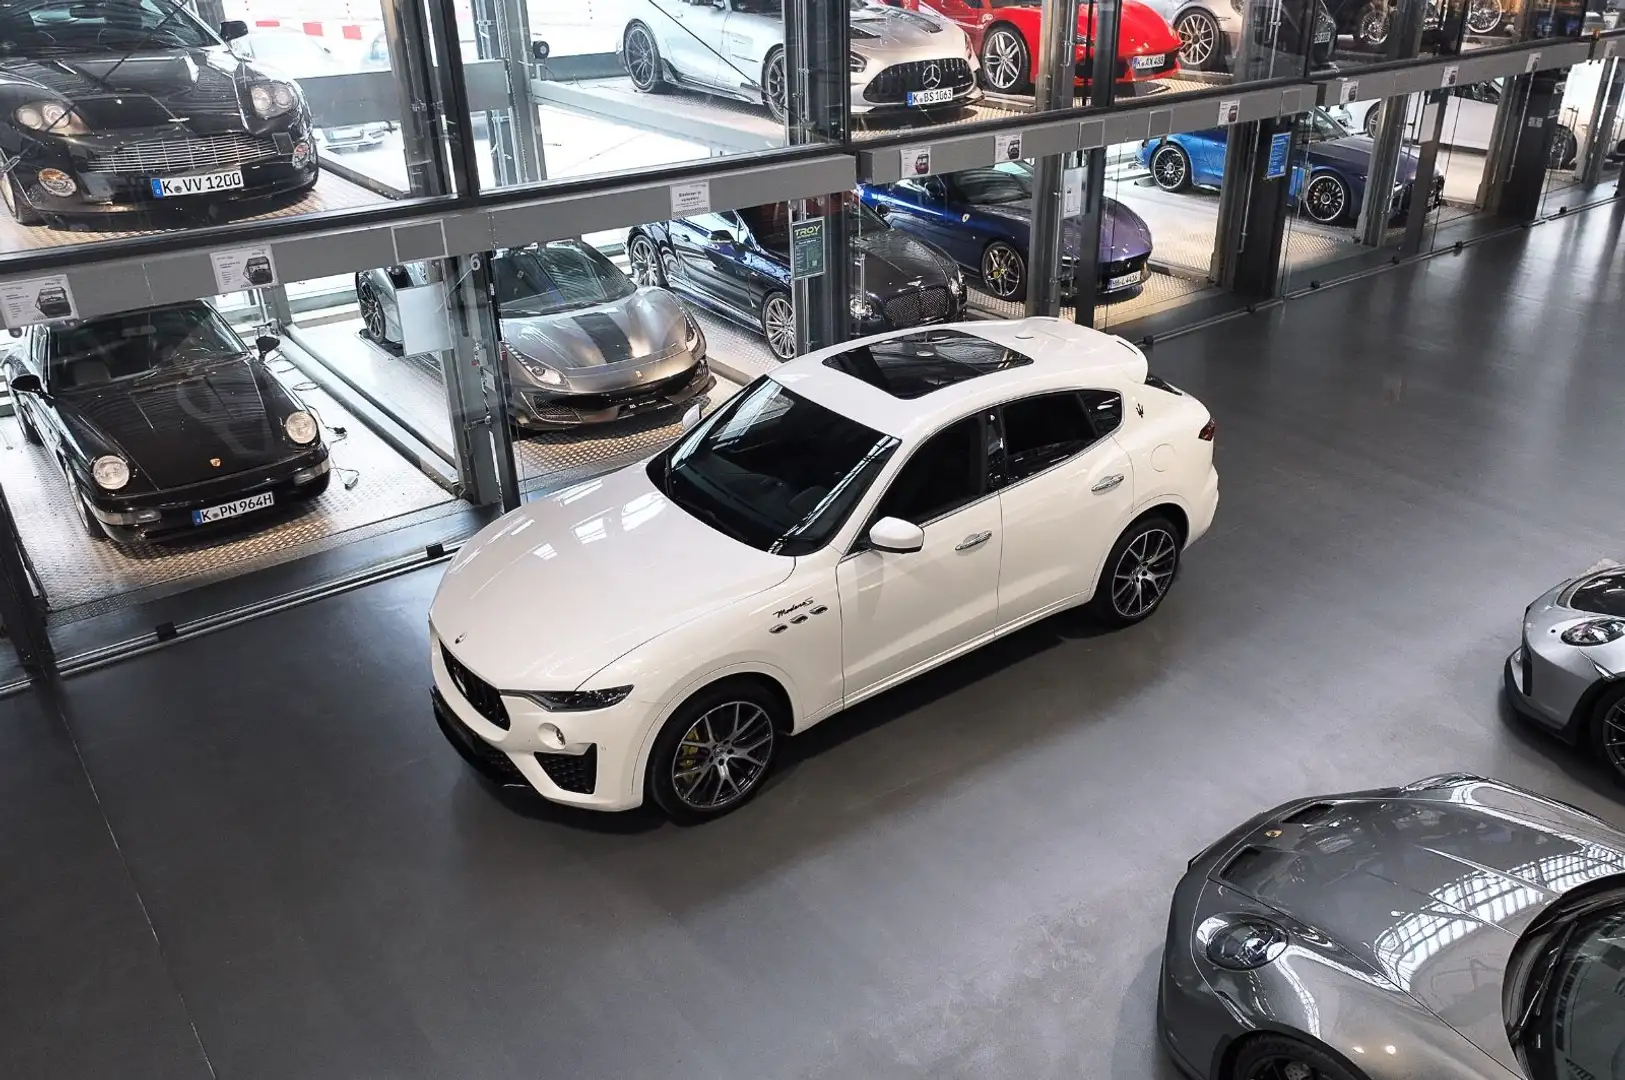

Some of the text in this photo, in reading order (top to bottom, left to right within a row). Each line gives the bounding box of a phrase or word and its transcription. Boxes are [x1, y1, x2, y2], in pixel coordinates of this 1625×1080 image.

[913, 89, 952, 103] K BS 1063
[162, 172, 241, 194] K VV 1200
[794, 224, 822, 236] TROY
[201, 493, 273, 522] K PN 964H
[772, 601, 806, 618] Modena
